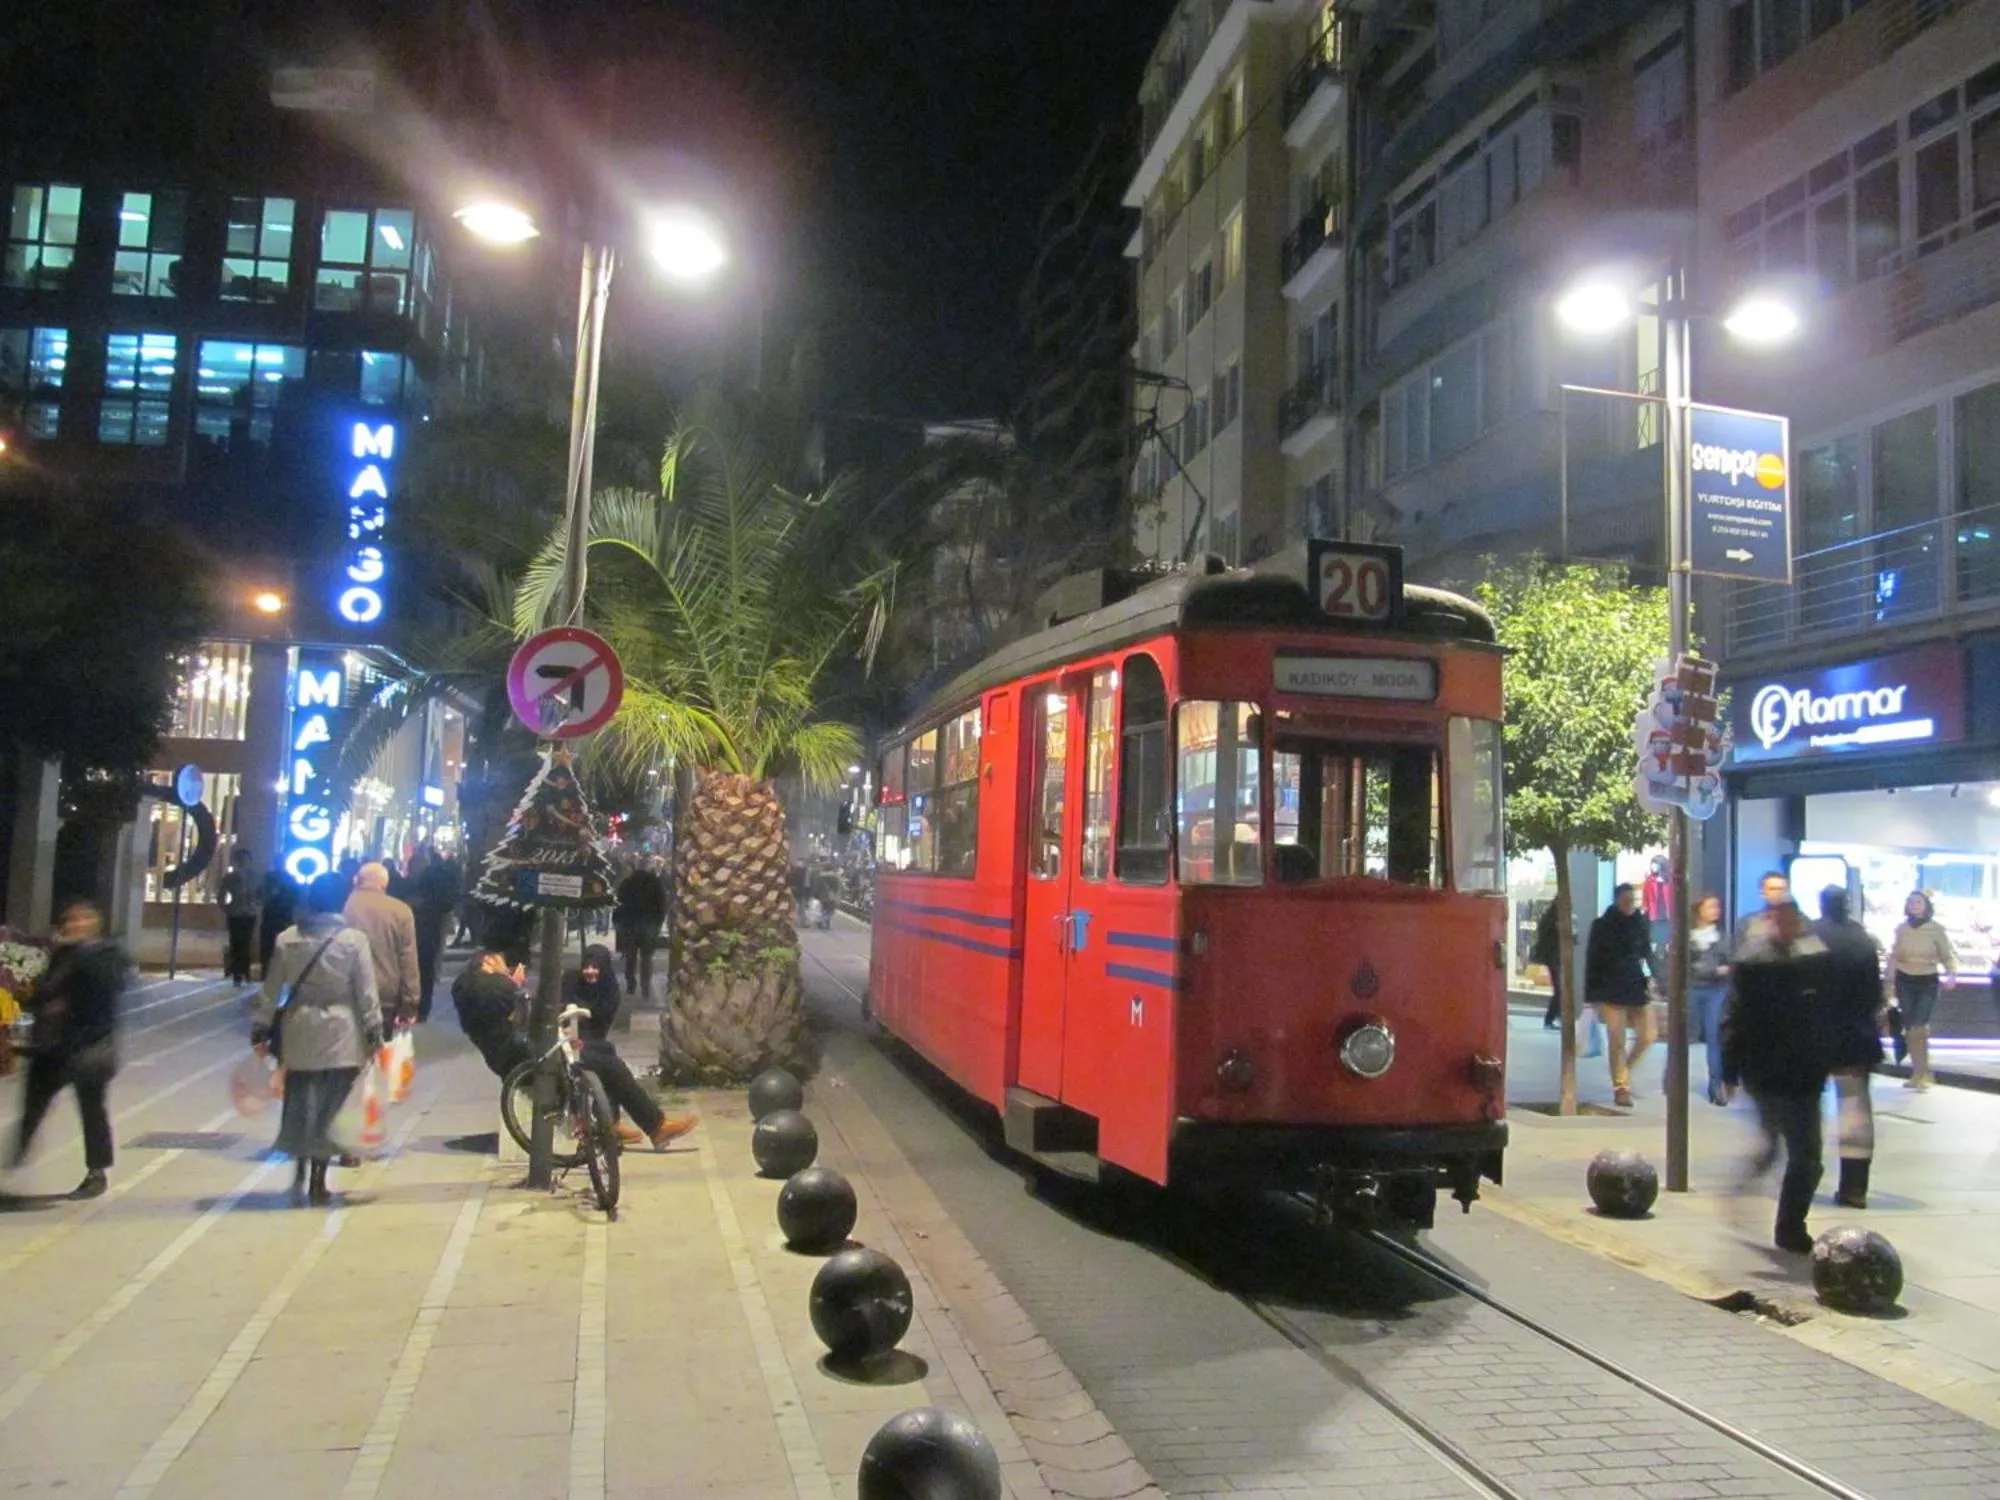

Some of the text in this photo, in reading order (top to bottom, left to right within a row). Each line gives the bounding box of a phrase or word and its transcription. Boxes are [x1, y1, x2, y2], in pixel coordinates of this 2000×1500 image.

[1324, 558, 1388, 615] 20
[1371, 673, 1419, 688] MODA
[1792, 684, 1907, 726] flormar
